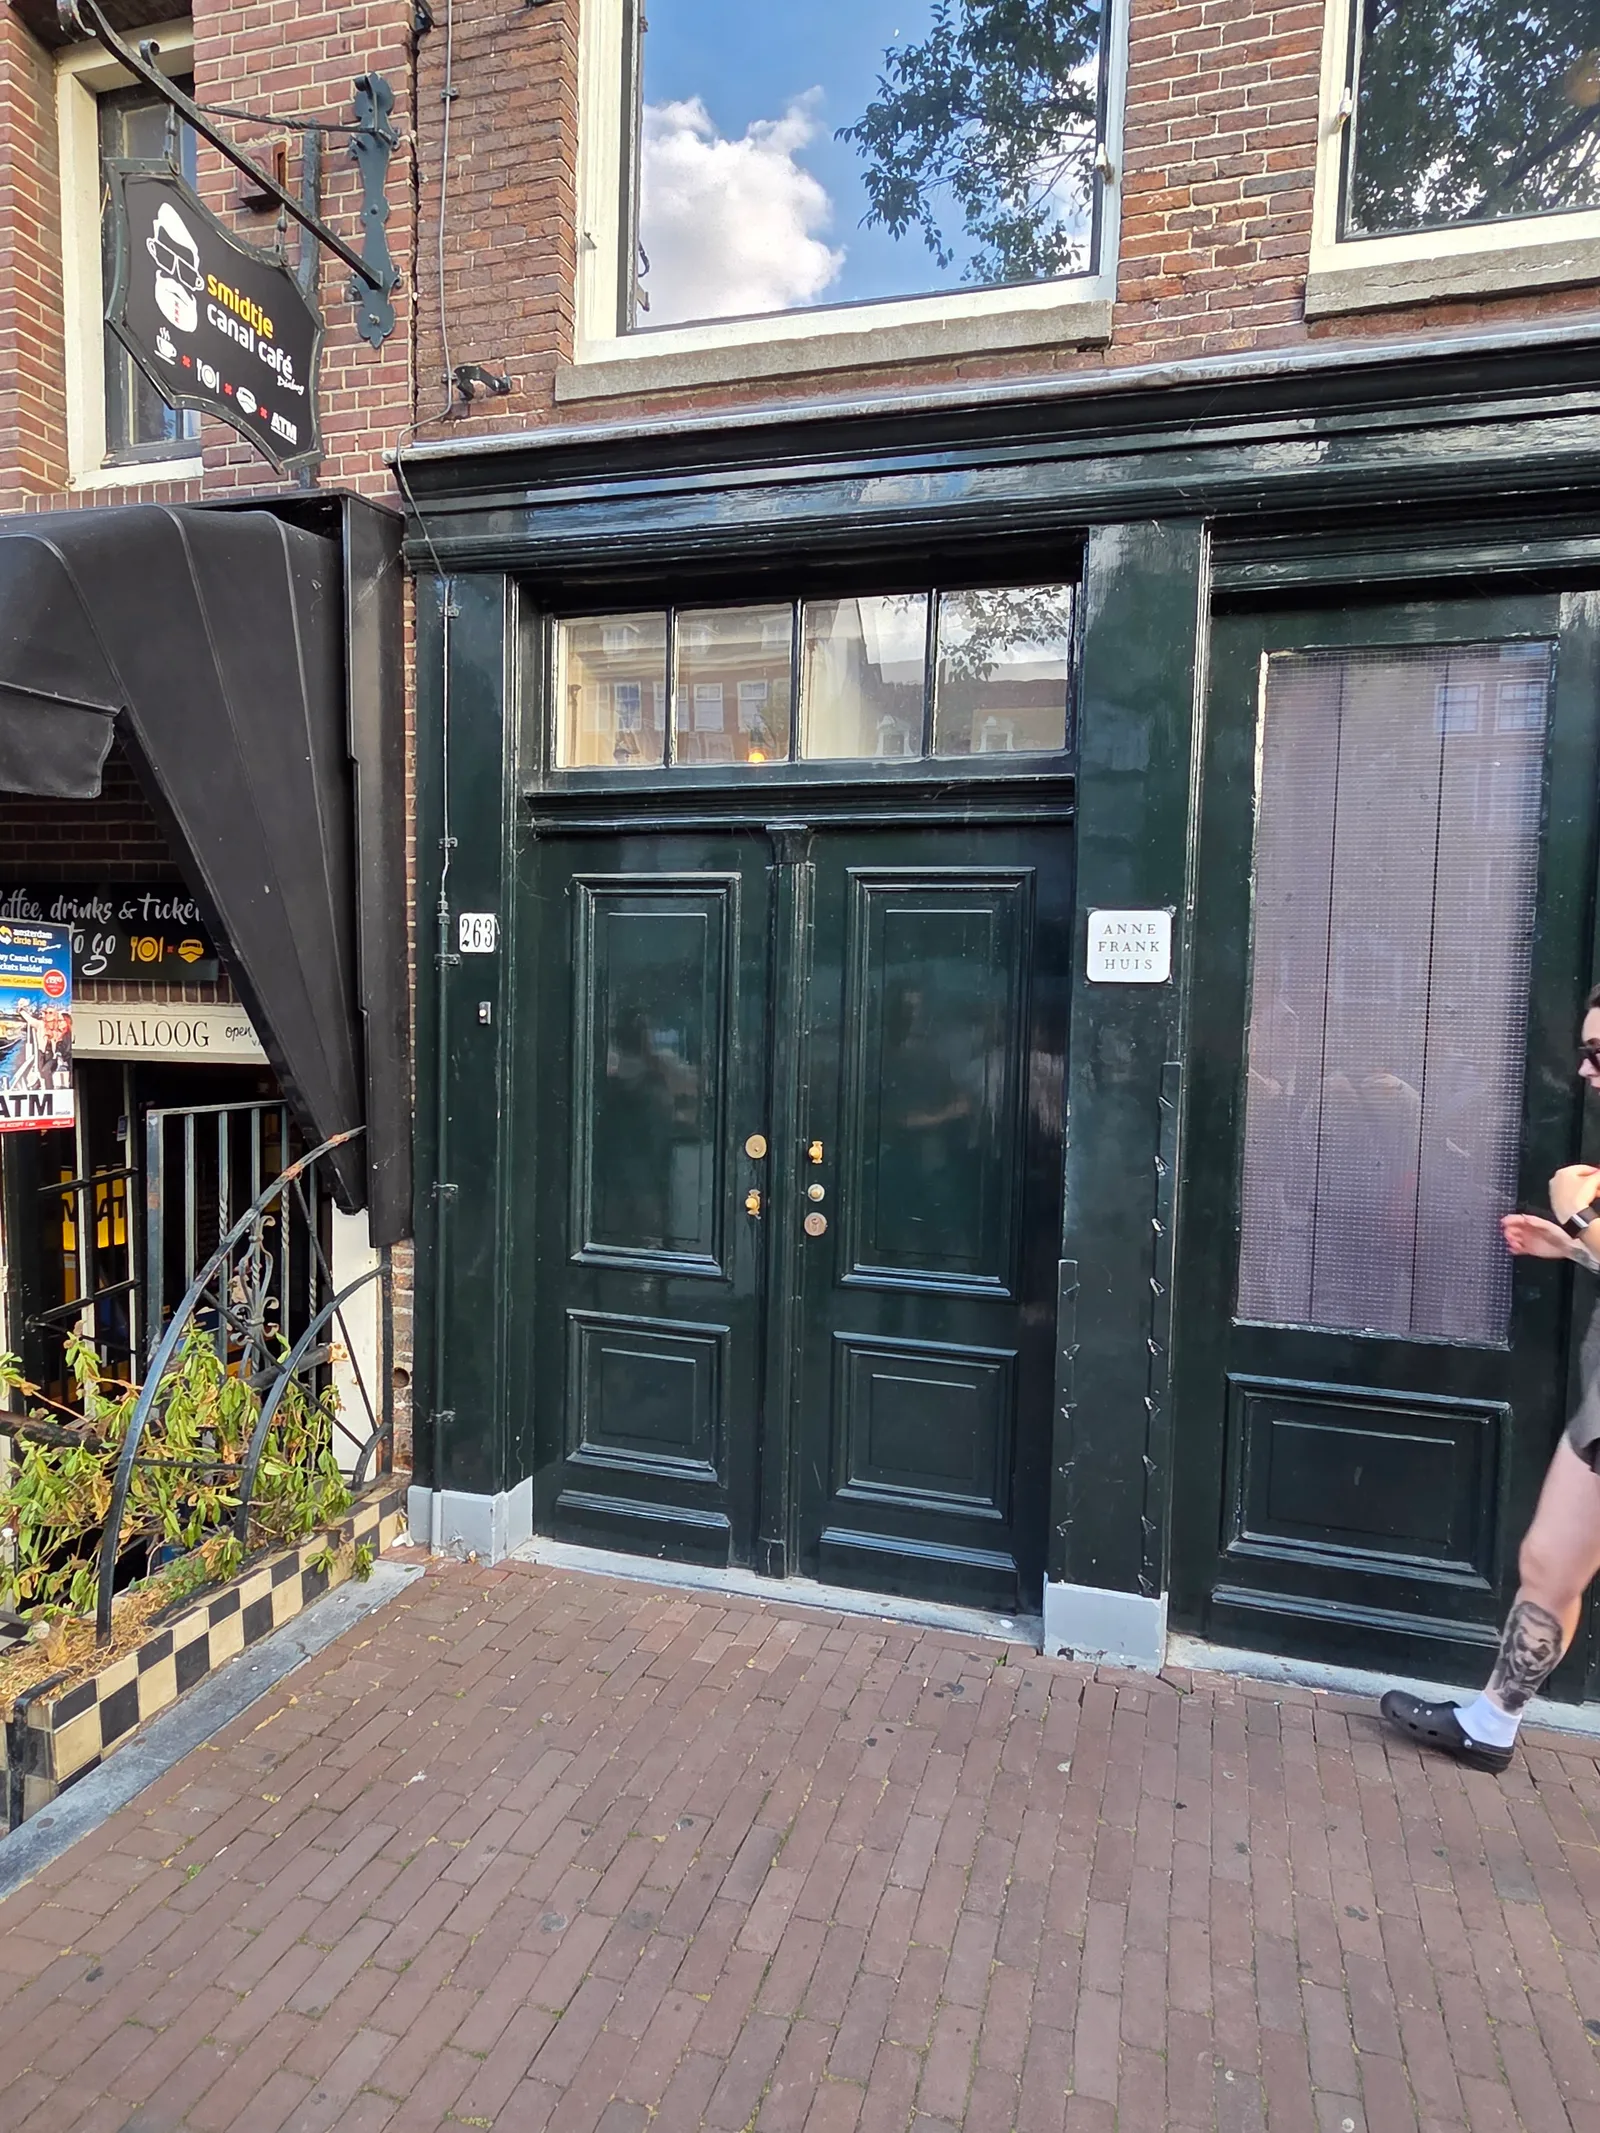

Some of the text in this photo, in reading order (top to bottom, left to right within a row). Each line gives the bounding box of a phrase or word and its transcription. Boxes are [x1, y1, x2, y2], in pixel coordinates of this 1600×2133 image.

[207, 274, 274, 339] smidtje
[207, 303, 293, 380] canal café
[271, 412, 298, 441] ATM
[50, 895, 113, 924] drinks
[118, 901, 138, 919] &
[13, 929, 53, 939] amsterdam
[461, 918, 493, 948] 263
[1103, 923, 1156, 935] ANNE
[13, 937, 47, 946] circle line
[1097, 941, 1160, 952] FRANK
[9, 954, 29, 962] Canal
[30, 956, 53, 964] Cruise
[82, 933, 116, 976] go
[0, 963, 18, 971] ckets
[1104, 959, 1153, 970] HUIS
[98, 1020, 209, 1047] DIALOOG
